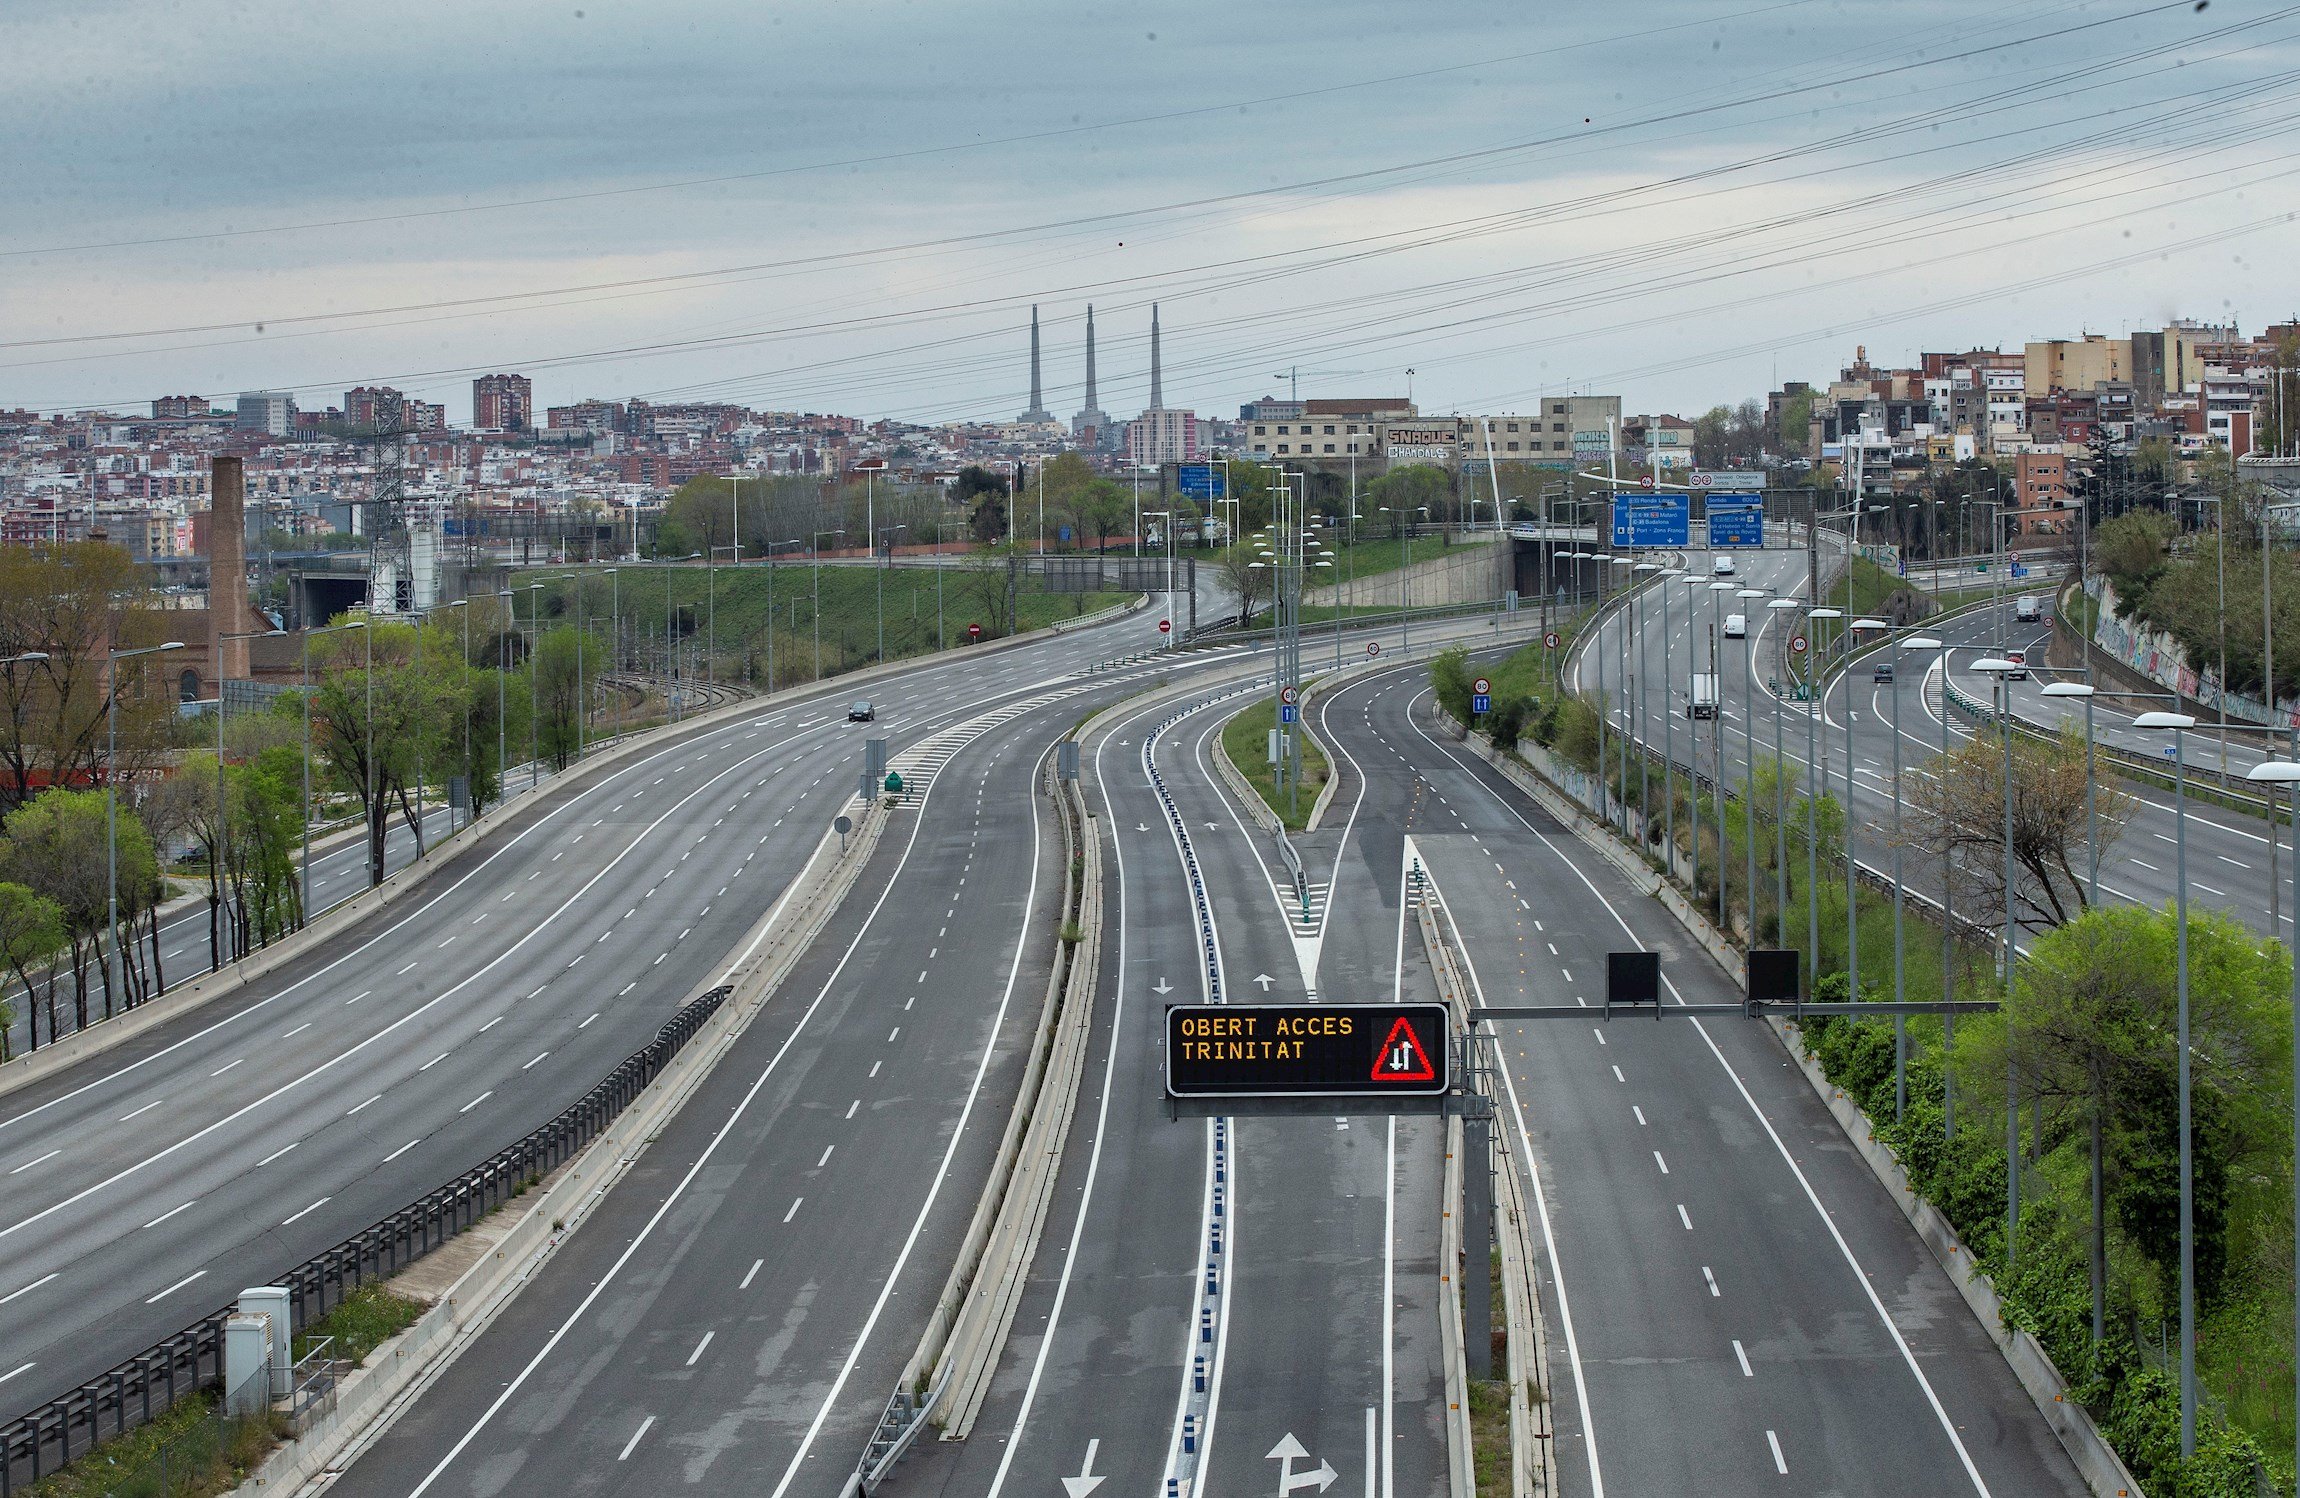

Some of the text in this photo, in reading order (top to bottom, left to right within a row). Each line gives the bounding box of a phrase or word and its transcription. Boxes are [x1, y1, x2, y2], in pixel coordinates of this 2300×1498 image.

[1182, 1017, 1353, 1036] OBERT ACCES
[1182, 1041, 1305, 1060] TRINITAT
